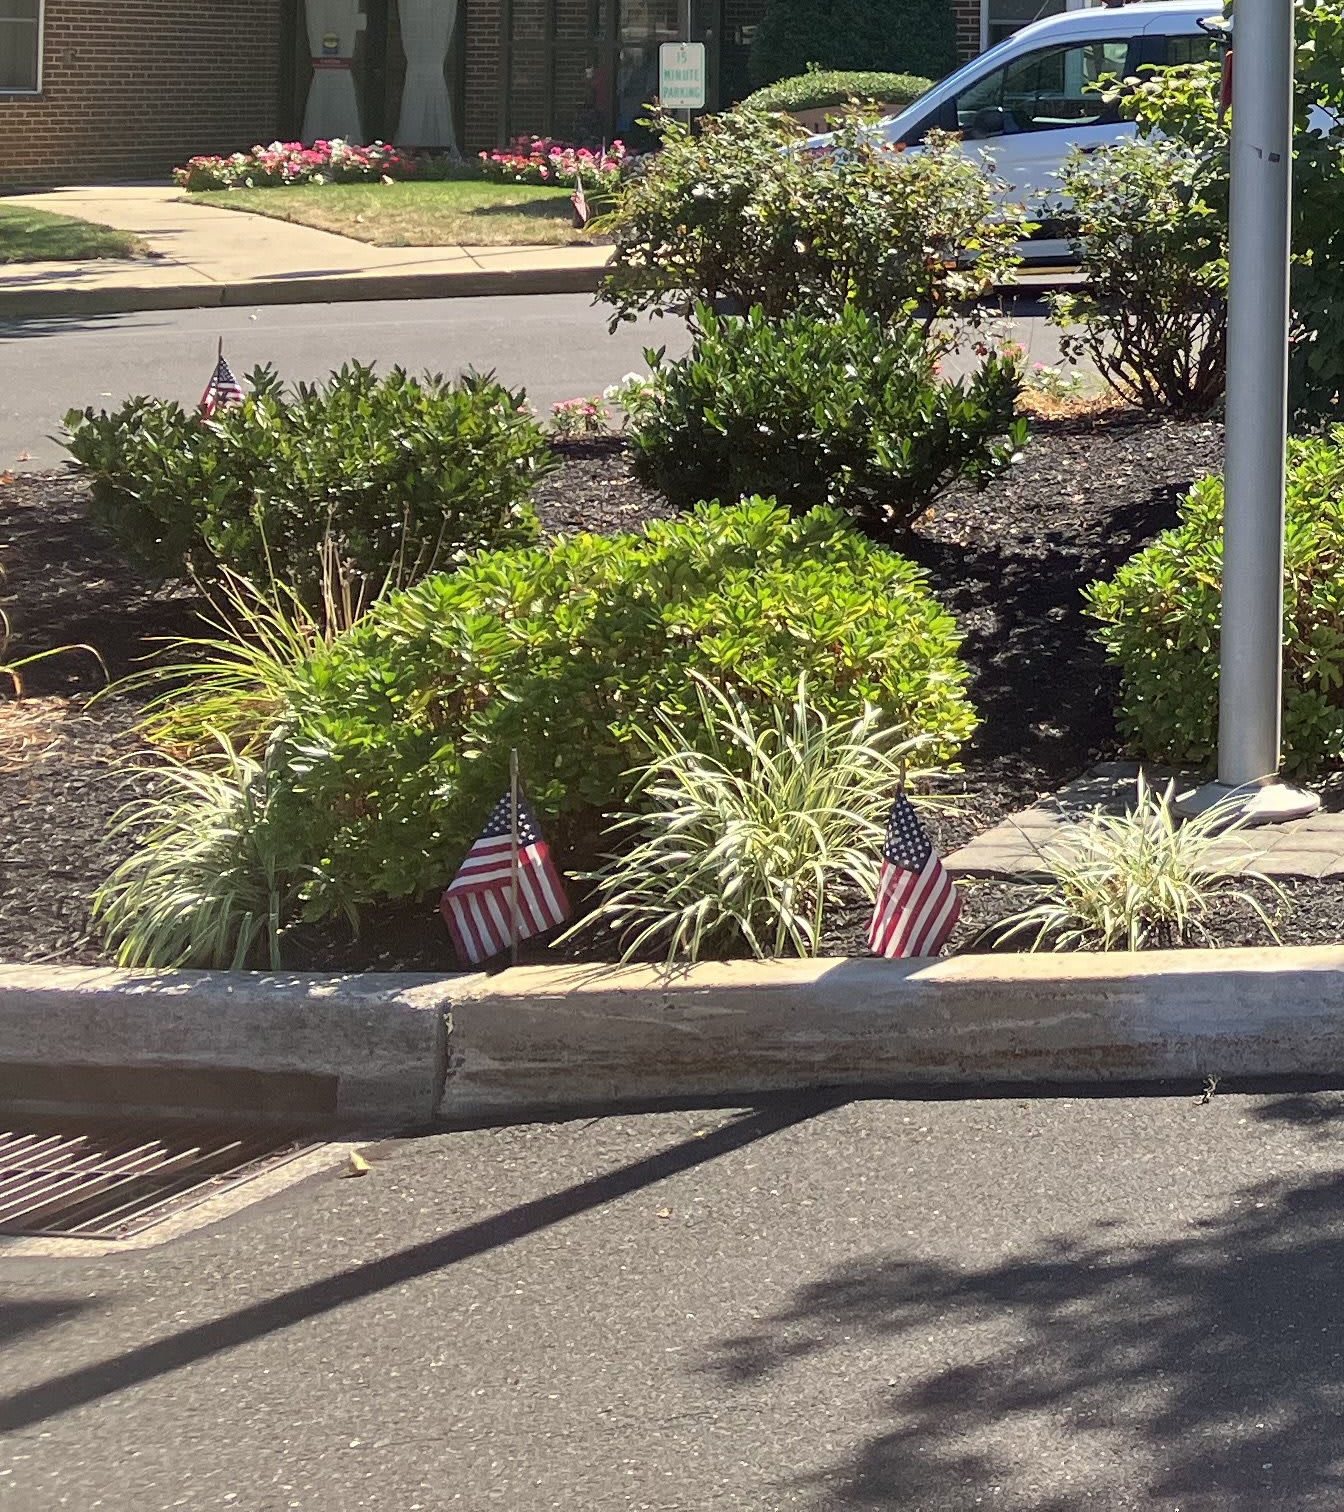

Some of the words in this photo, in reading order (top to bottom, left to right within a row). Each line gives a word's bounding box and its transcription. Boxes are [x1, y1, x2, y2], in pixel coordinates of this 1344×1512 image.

[677, 52, 688, 64] 15
[664, 70, 699, 81] MINUTE
[663, 87, 701, 98] PARKING
